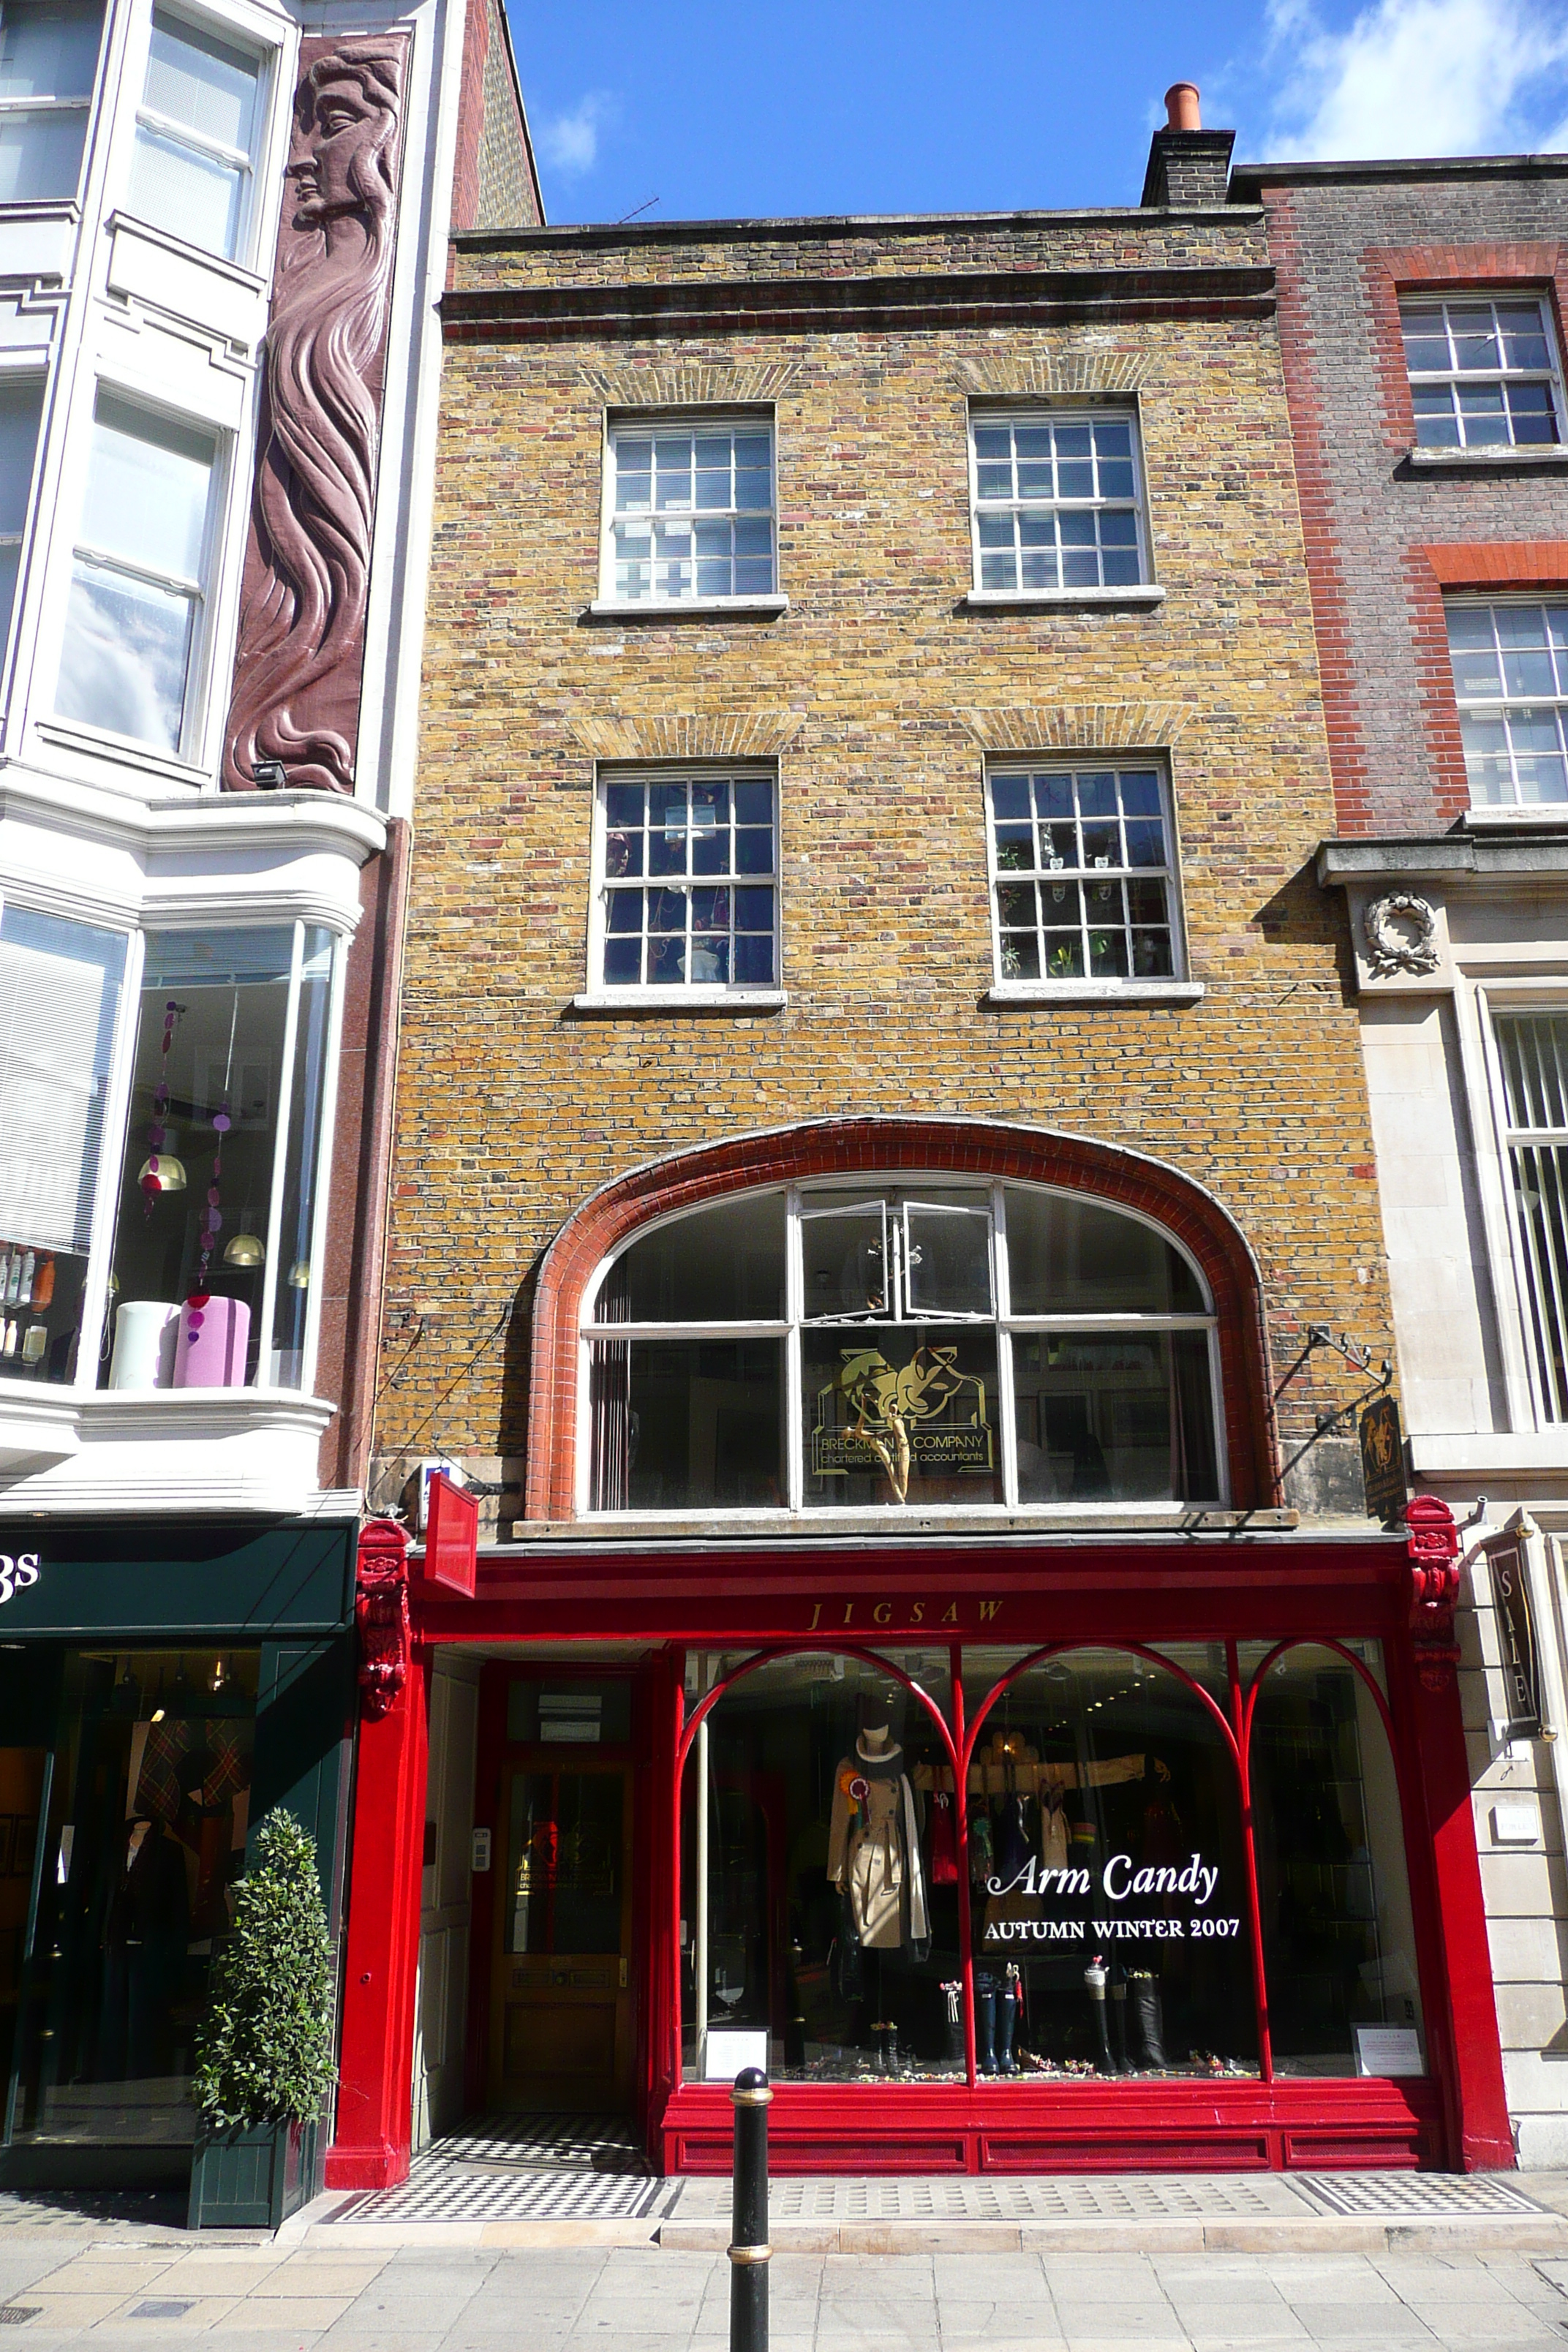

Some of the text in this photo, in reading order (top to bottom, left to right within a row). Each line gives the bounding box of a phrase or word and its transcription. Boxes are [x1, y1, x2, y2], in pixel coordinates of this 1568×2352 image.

[821, 1436, 894, 1450] BRECKMN
[913, 1435, 984, 1449] COMPANY
[821, 1451, 984, 1463] chartered ctified accountants
[806, 1601, 1004, 1631] JIGSAW
[987, 1853, 1218, 1904] Arm Candy
[984, 1918, 1240, 1940] AUTUMN WINTER 2007
